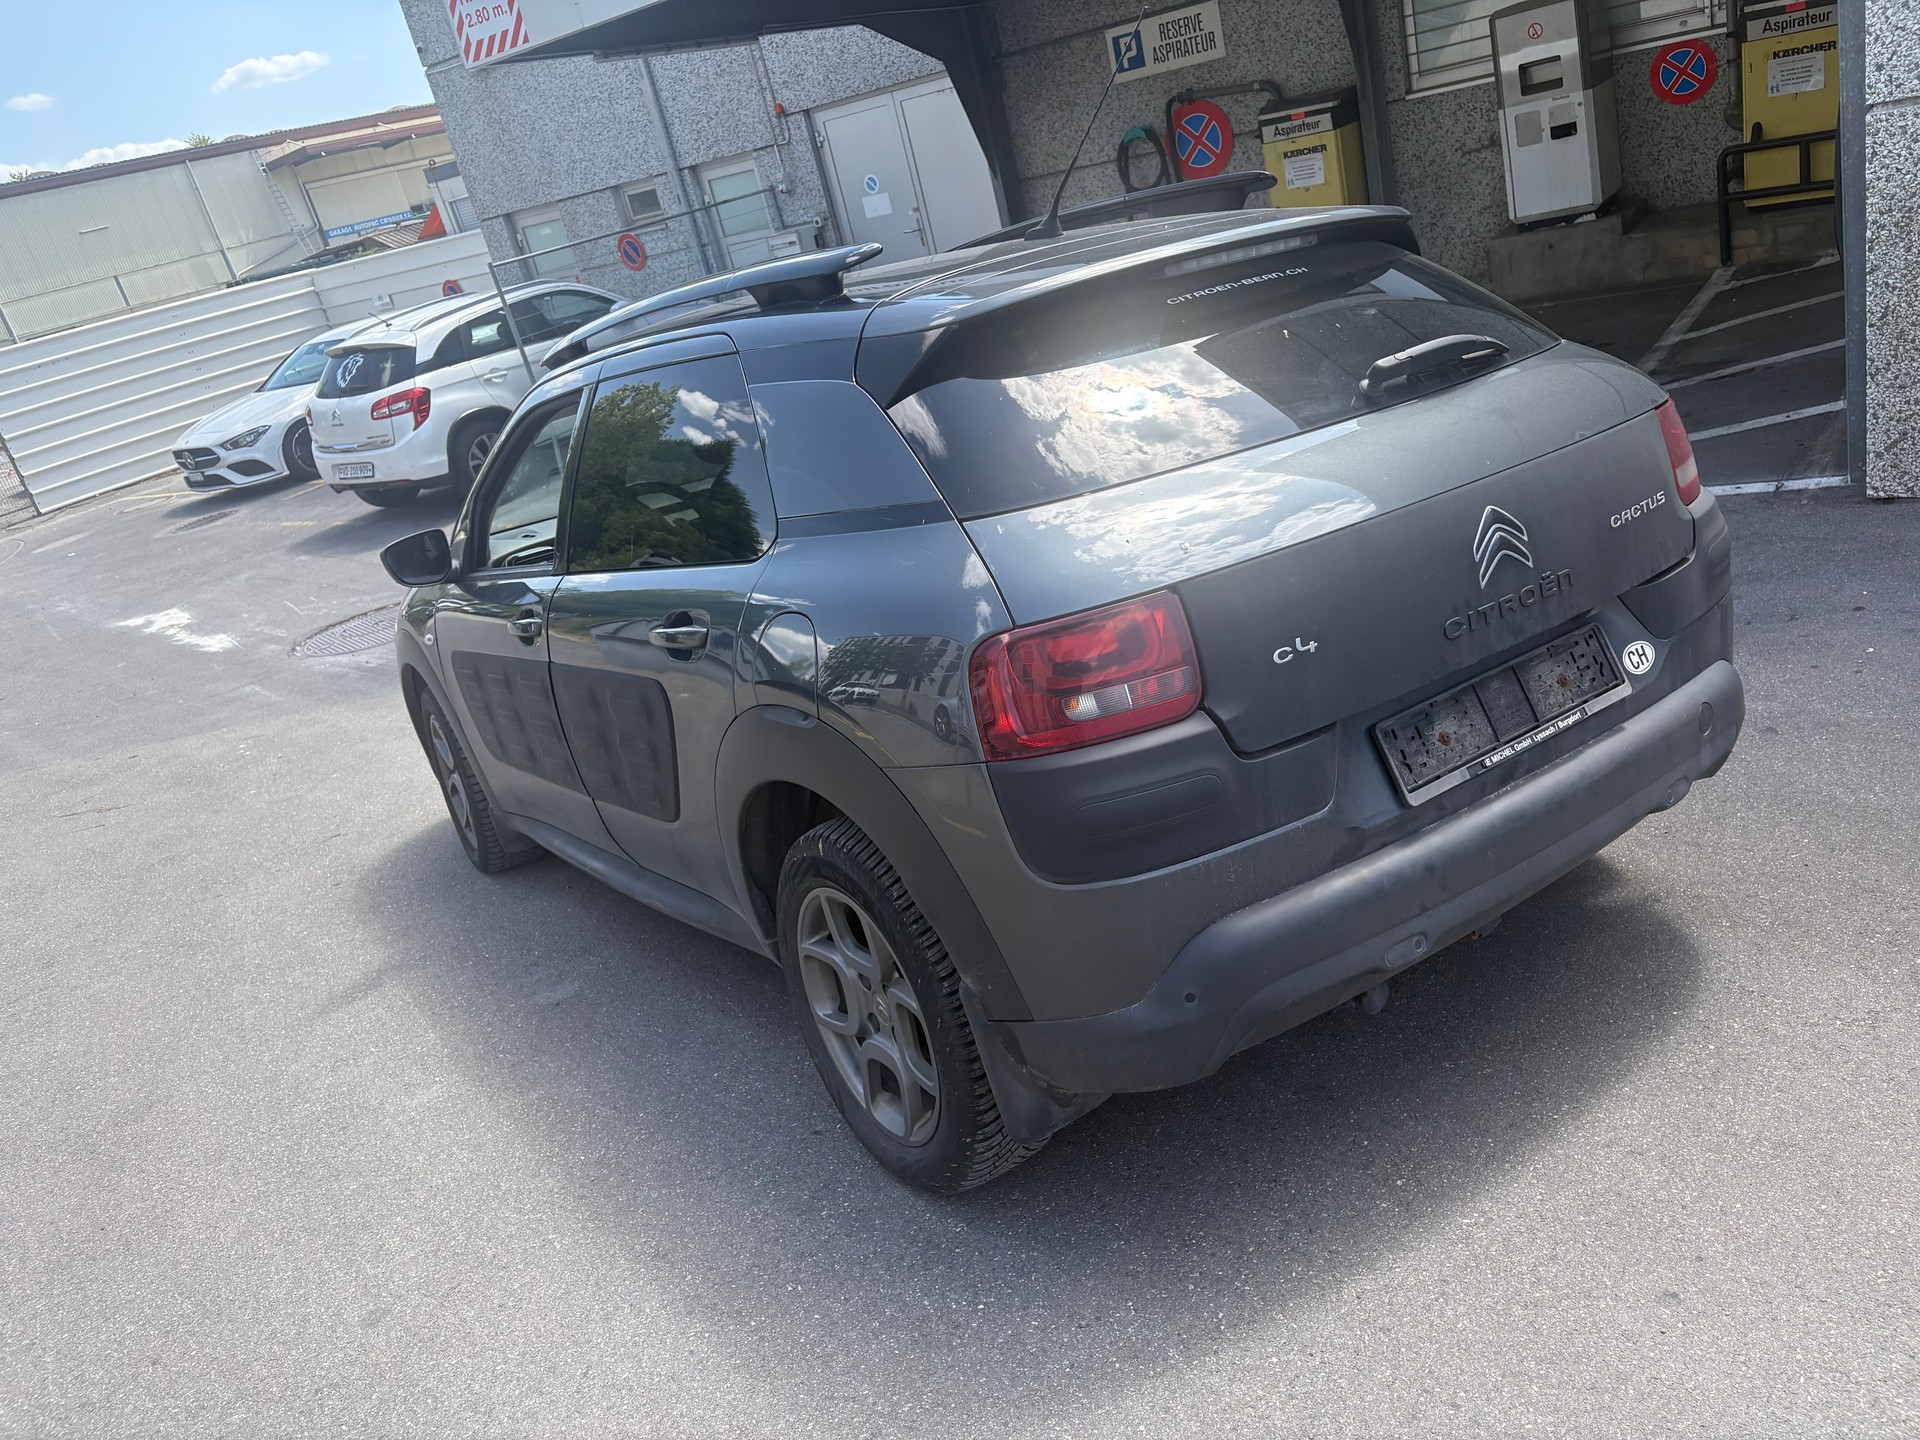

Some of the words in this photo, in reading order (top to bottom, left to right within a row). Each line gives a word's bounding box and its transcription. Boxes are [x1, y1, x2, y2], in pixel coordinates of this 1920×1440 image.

[465, 6, 490, 28] 2.80
[492, 4, 508, 18] m.
[1158, 12, 1205, 42] RESERVE
[1762, 11, 1833, 34] Aspirateur
[1152, 31, 1217, 65] ASPIRATEUR
[1273, 120, 1321, 138] Aspirateur
[328, 225, 353, 237] GARAGE
[1610, 490, 1666, 528] CACTUS
[1627, 645, 1650, 670] CH
[1491, 747, 1516, 763] MICHEL
[1514, 738, 1533, 752] GmbH
[1533, 726, 1556, 742] Lyssach
[1557, 711, 1582, 729] Burgdorf
